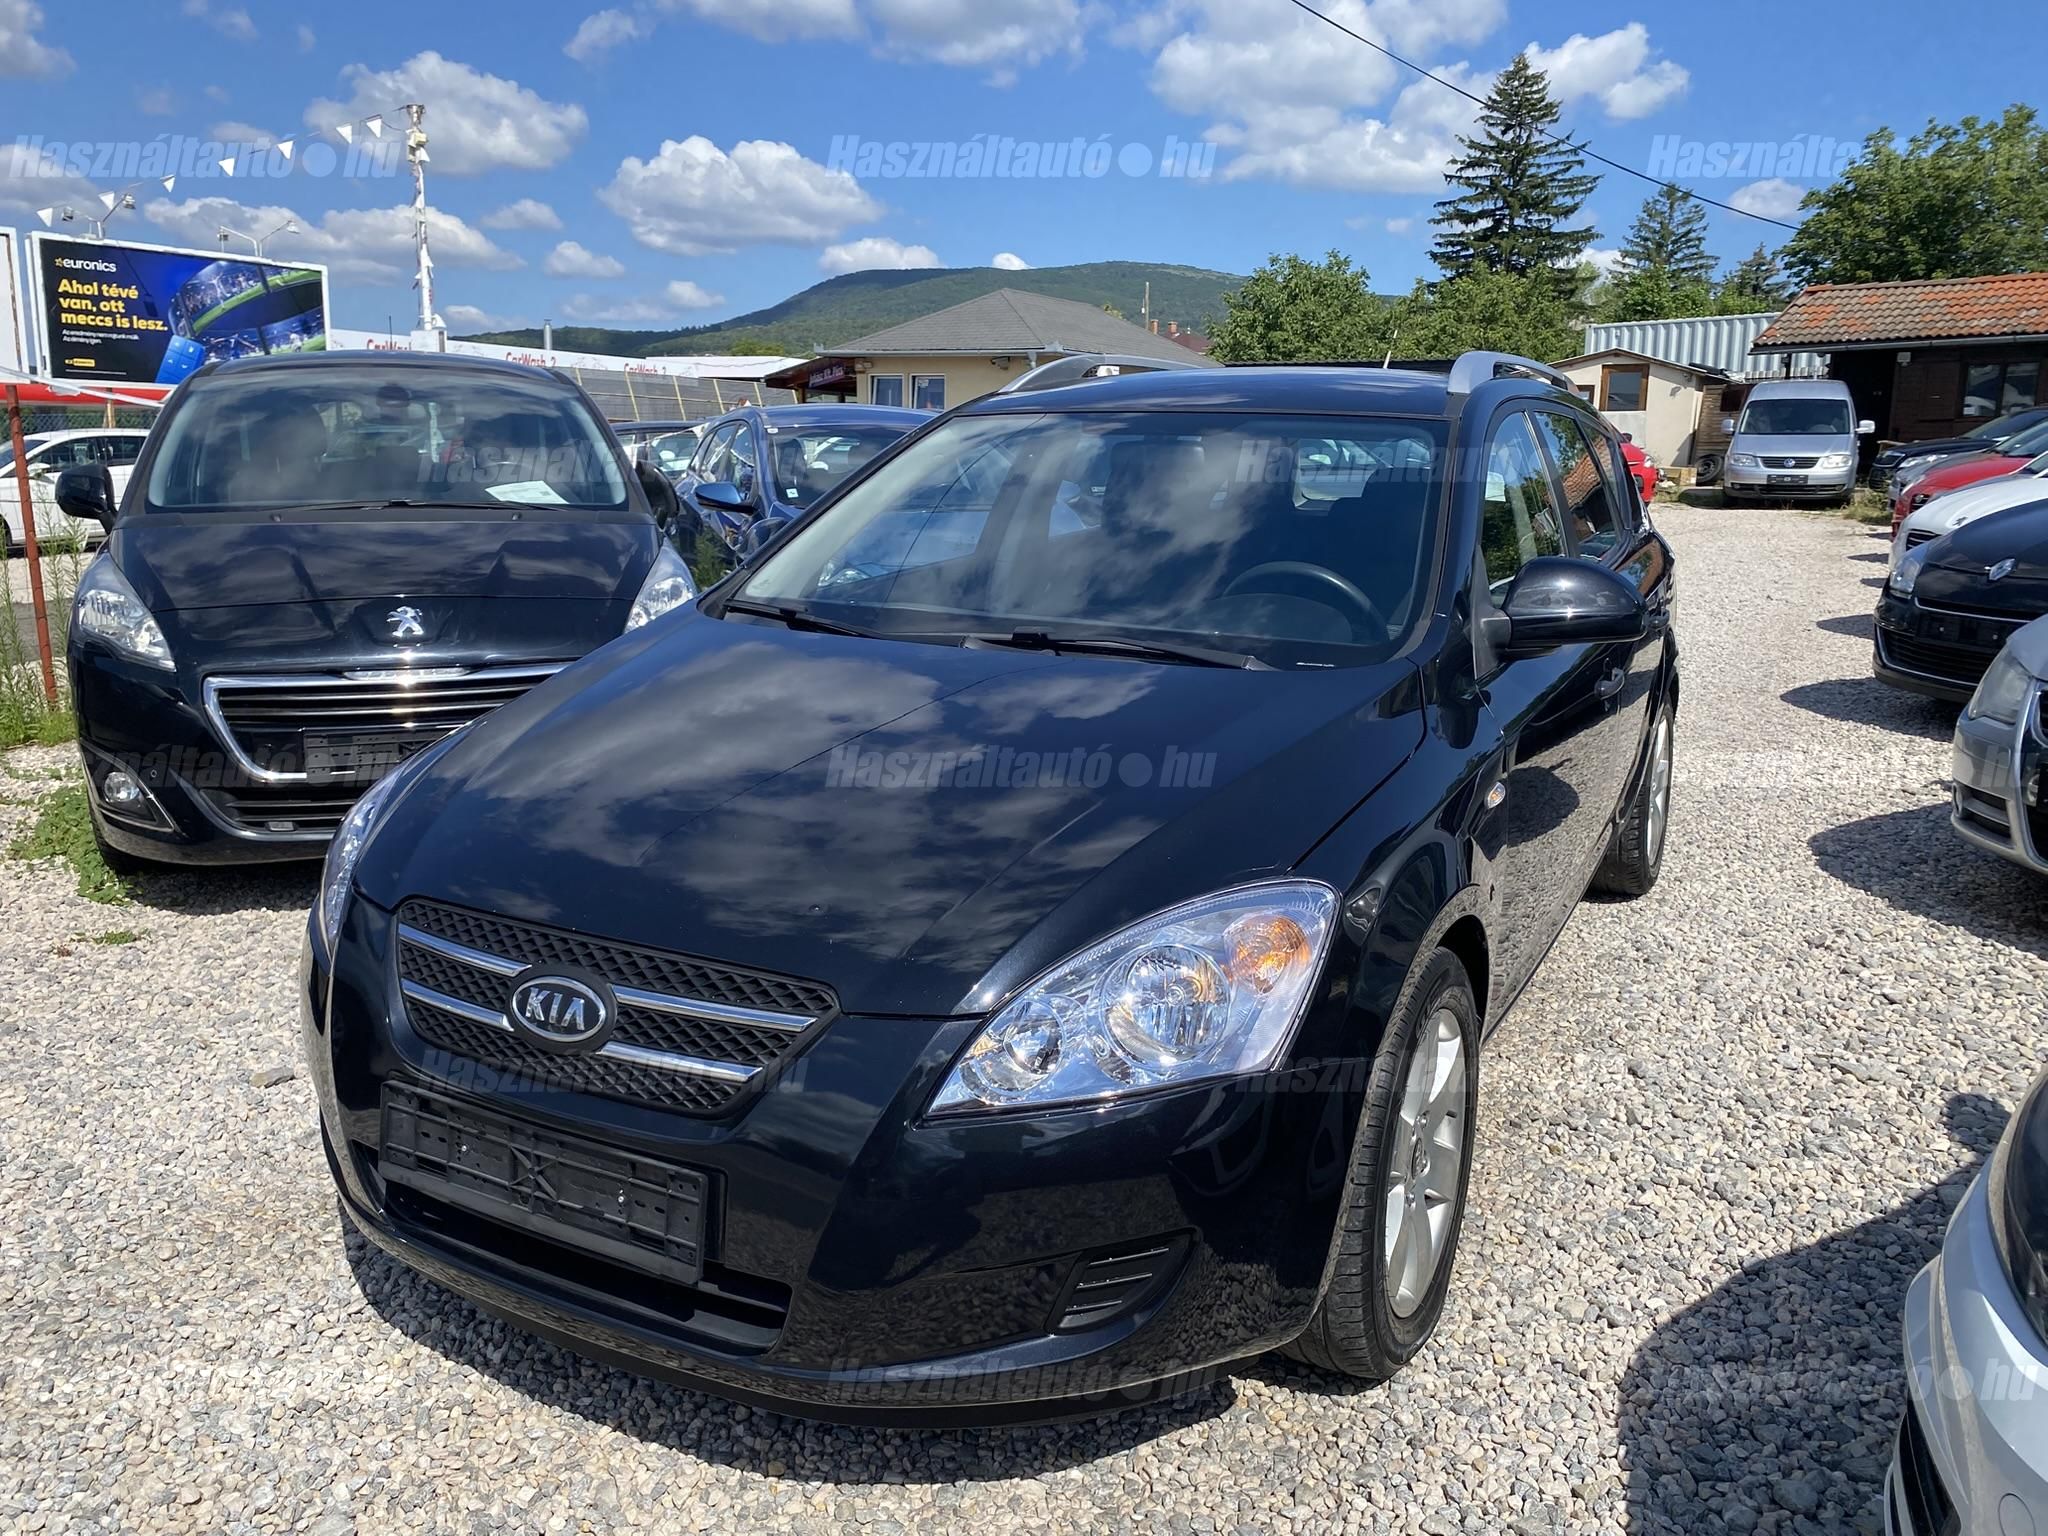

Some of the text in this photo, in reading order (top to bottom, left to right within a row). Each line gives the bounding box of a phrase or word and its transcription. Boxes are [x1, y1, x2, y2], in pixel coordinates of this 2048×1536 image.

[63, 258, 117, 272] euronics
[58, 278, 139, 299] Ahol tévé
[59, 297, 126, 313] van, ott
[61, 312, 168, 331] meccs is lesz.
[525, 986, 586, 1031] KIA
